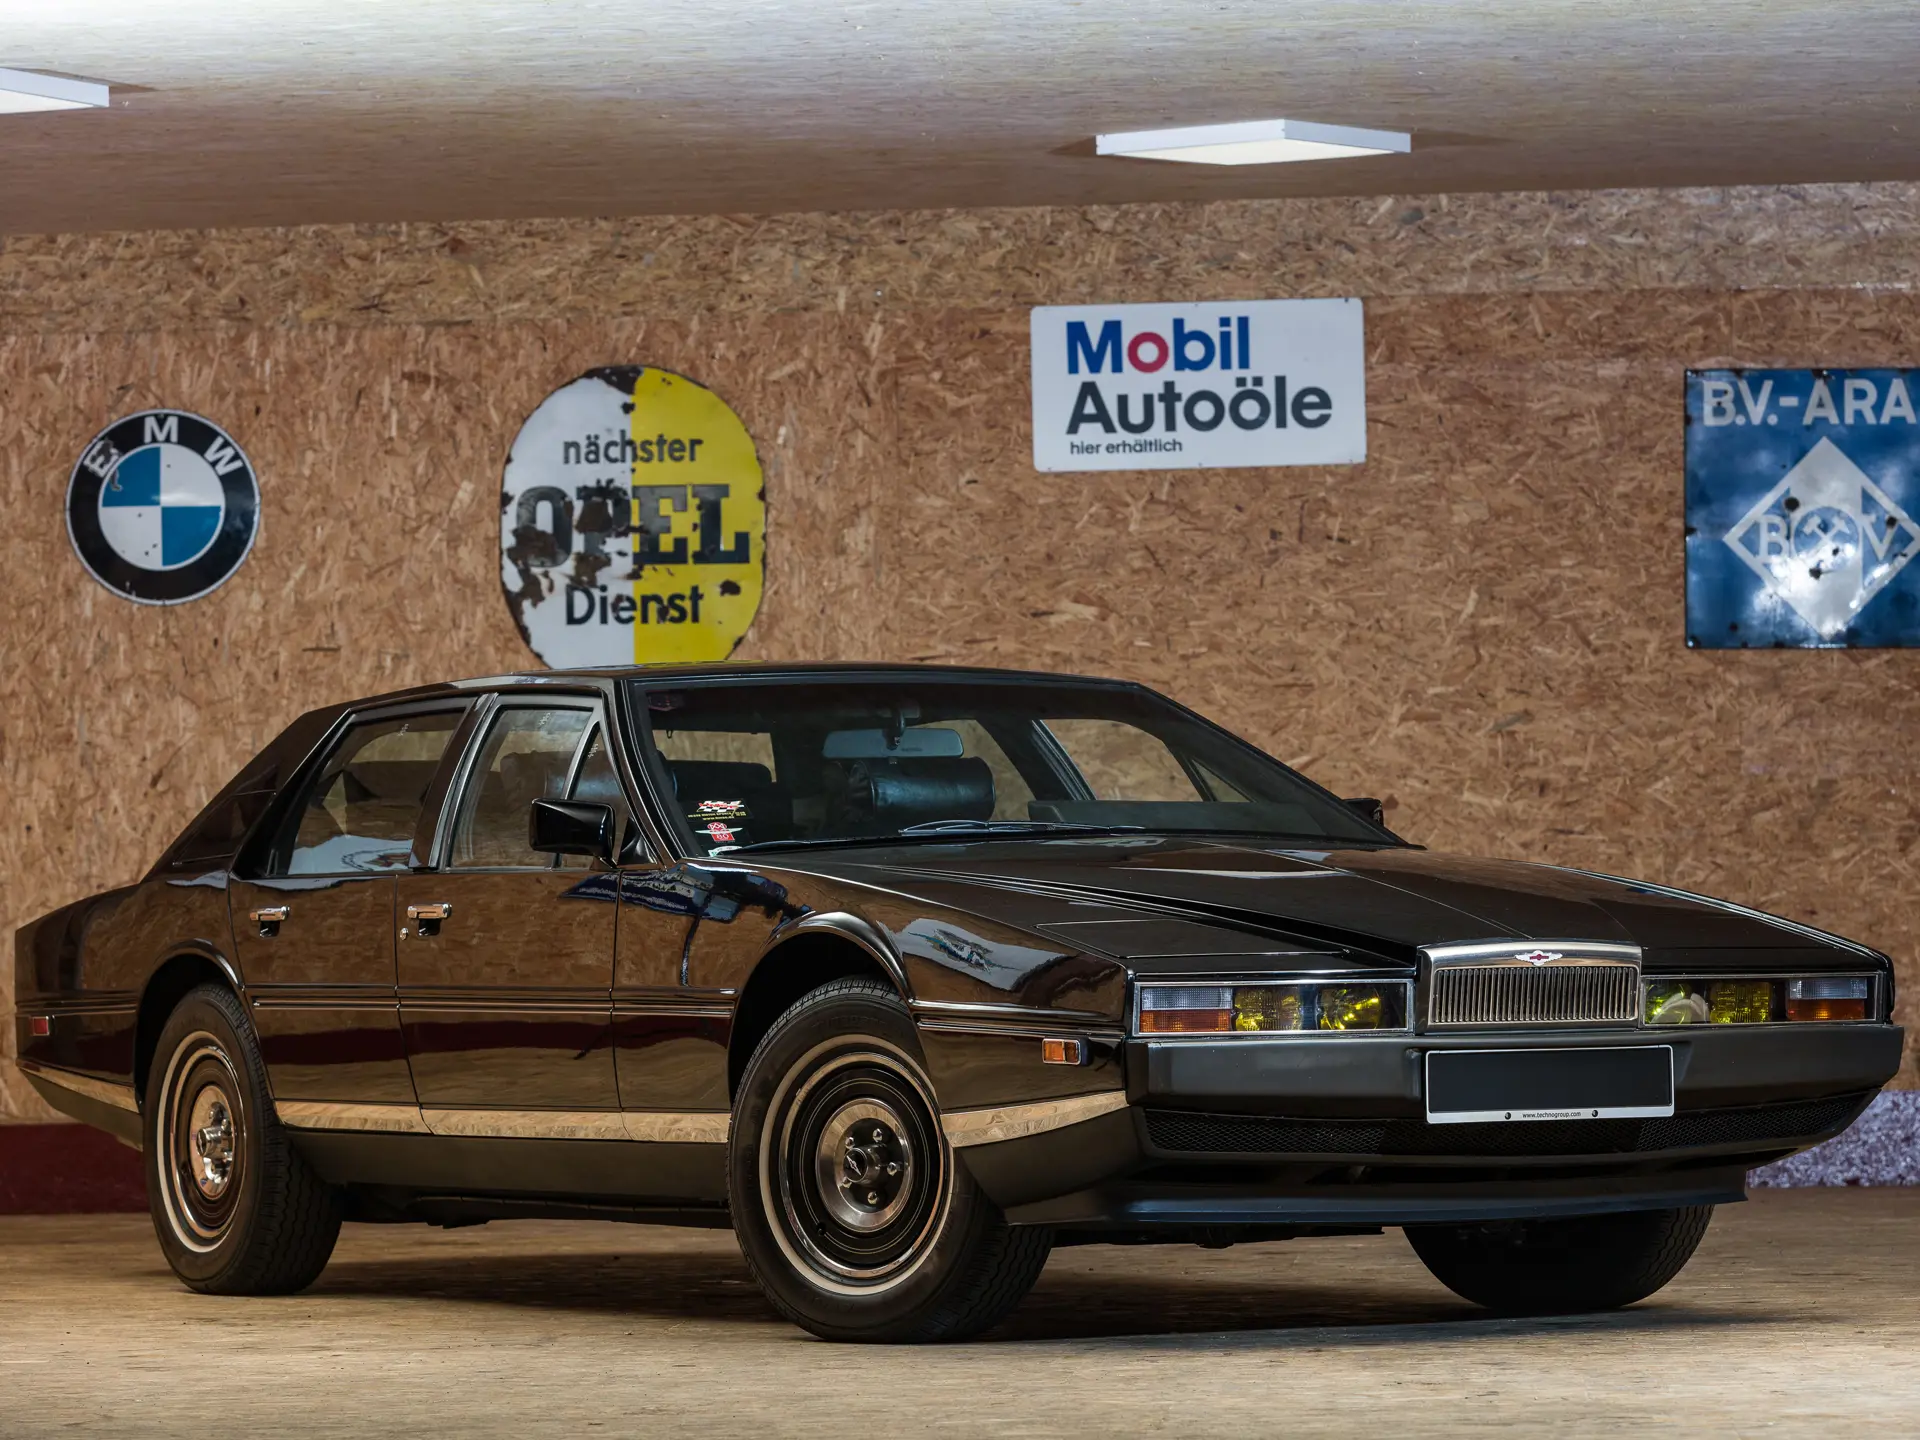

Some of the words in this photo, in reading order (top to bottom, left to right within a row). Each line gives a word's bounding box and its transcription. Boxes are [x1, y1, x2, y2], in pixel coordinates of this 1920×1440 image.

[1066, 316, 1250, 375] Mobil
[1066, 375, 1332, 435] Autoöle
[83, 415, 244, 478] BMW
[563, 429, 704, 464] nächster
[1070, 441, 1102, 455] hier
[1105, 438, 1183, 454] erhältlich
[516, 483, 750, 568] OPEL
[565, 584, 701, 626] Dienst
